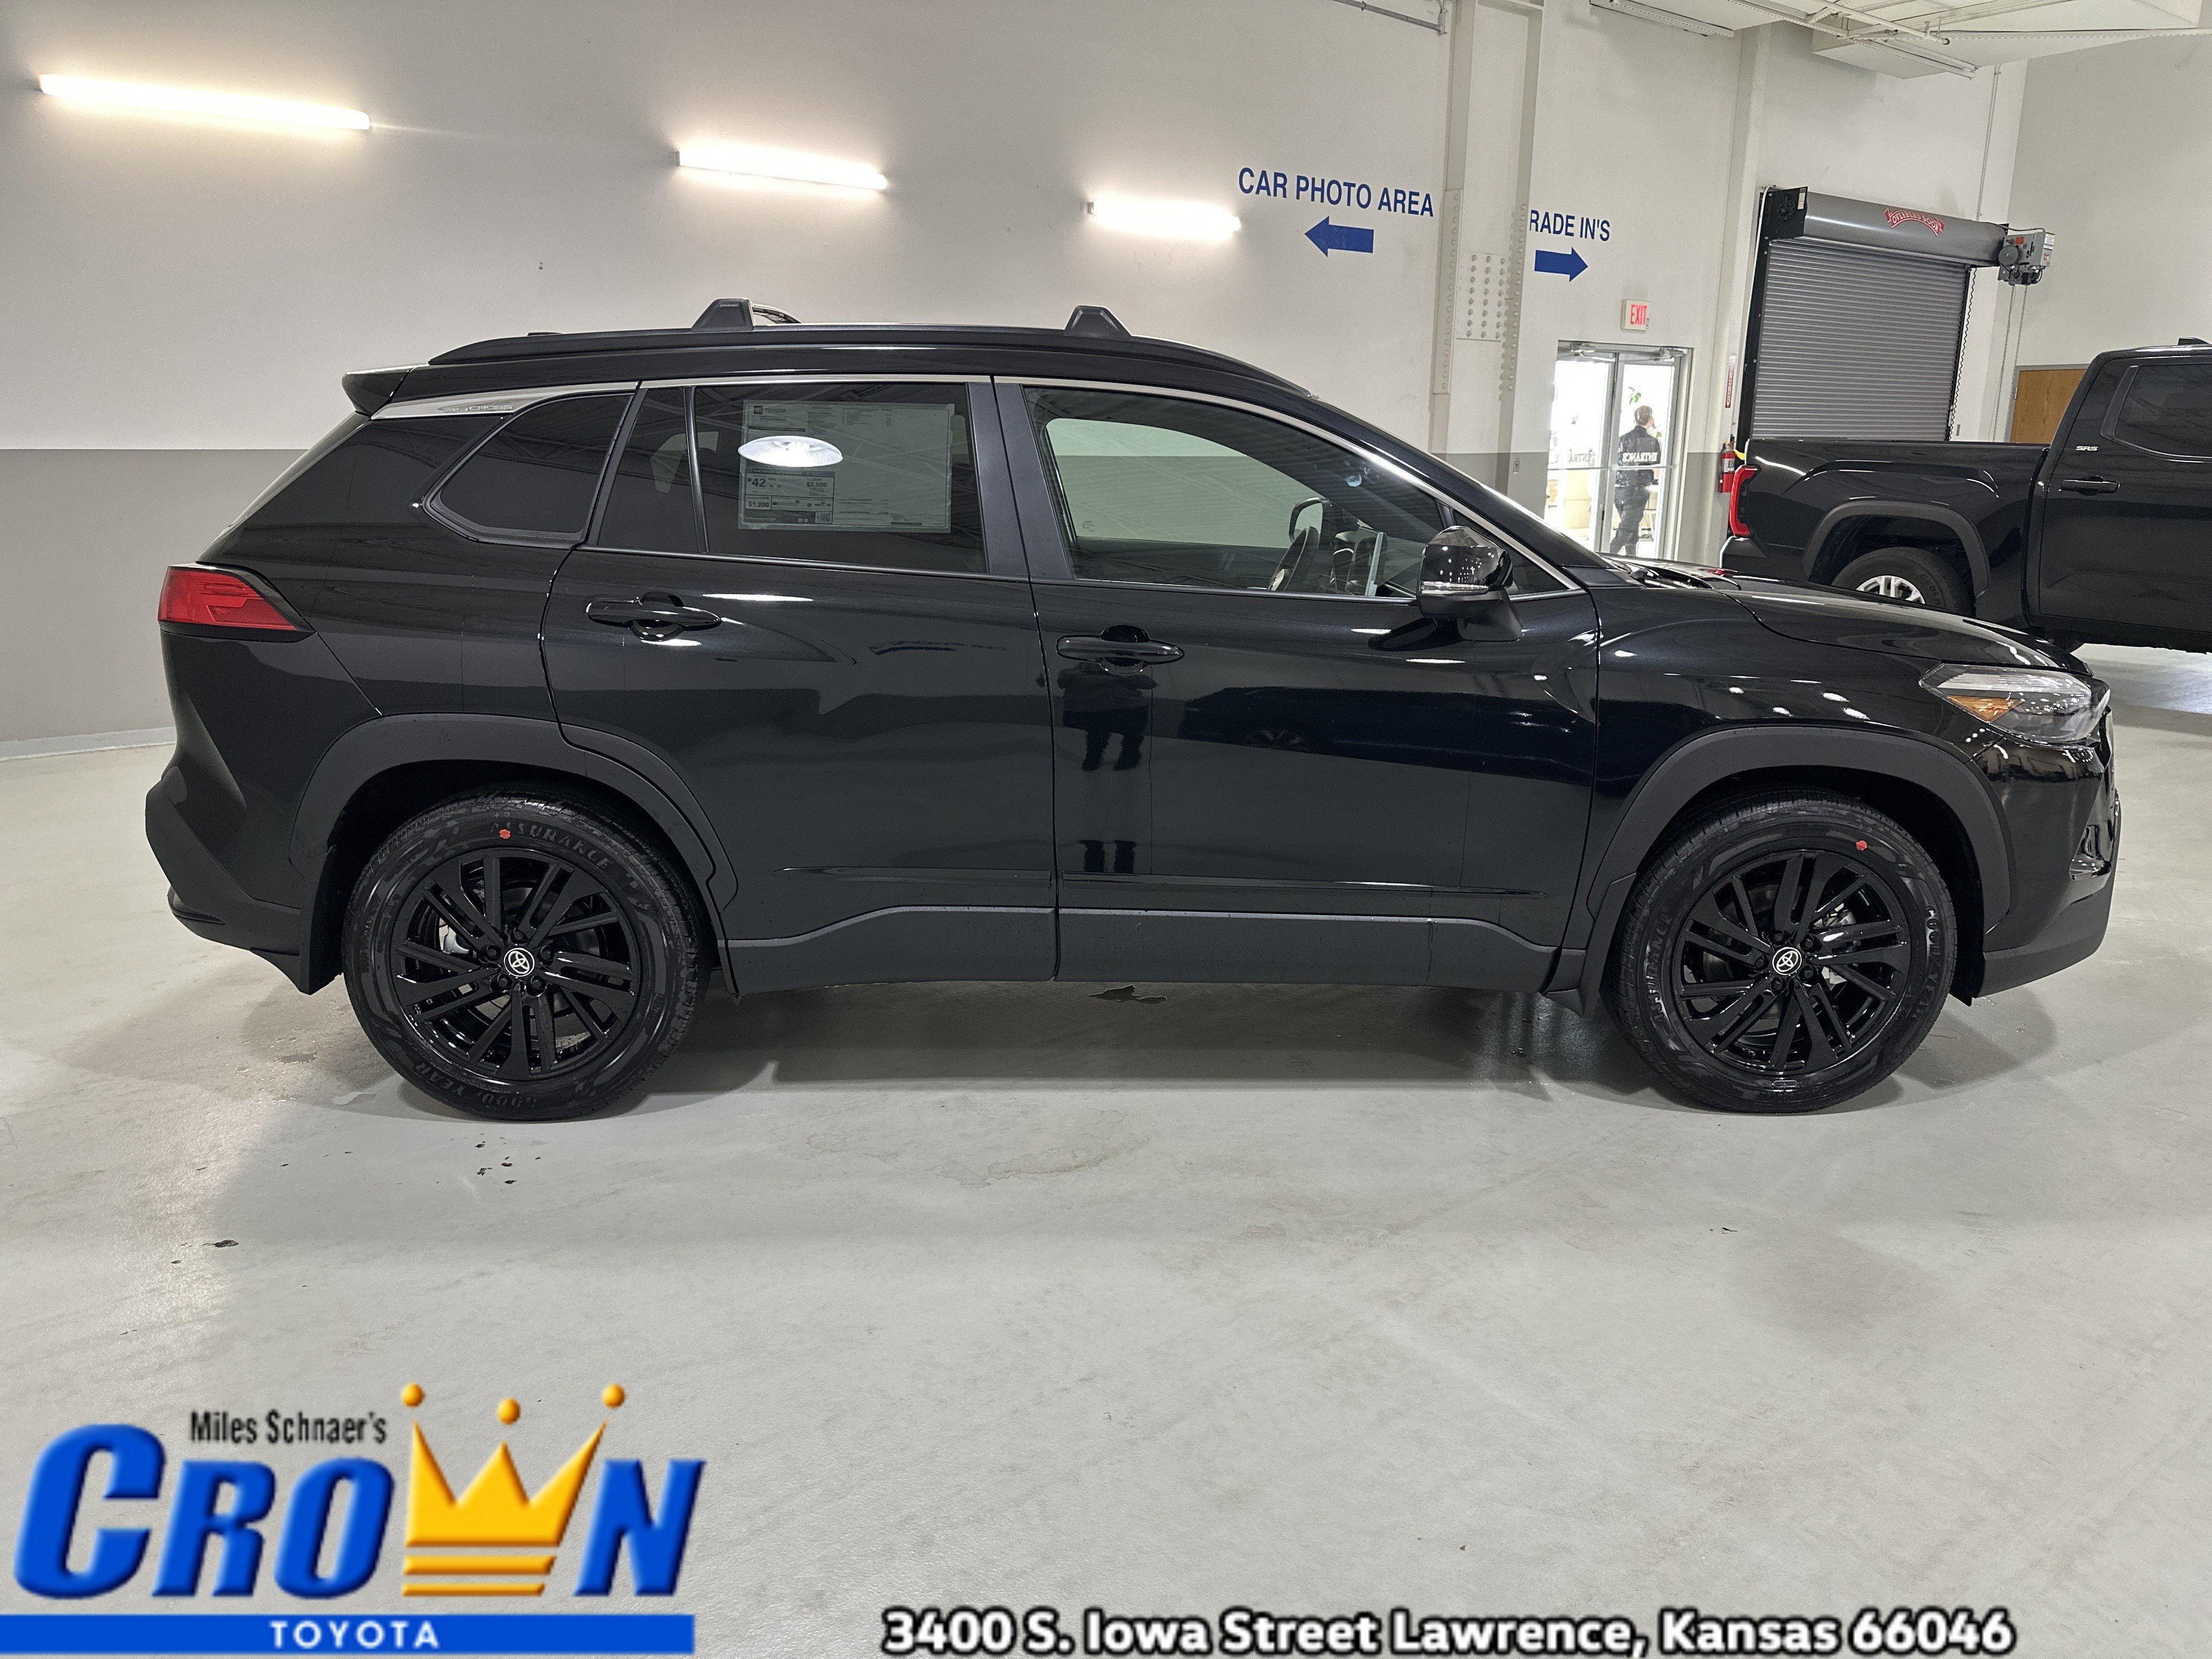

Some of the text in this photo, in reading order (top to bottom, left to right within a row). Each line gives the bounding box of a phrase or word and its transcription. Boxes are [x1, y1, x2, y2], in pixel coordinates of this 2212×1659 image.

[1238, 167, 1434, 217] CAR PHOTO AREA
[1530, 210, 1610, 241] RADE IN'S
[1630, 304, 1647, 325] EXIT
[752, 478, 766, 488] 42
